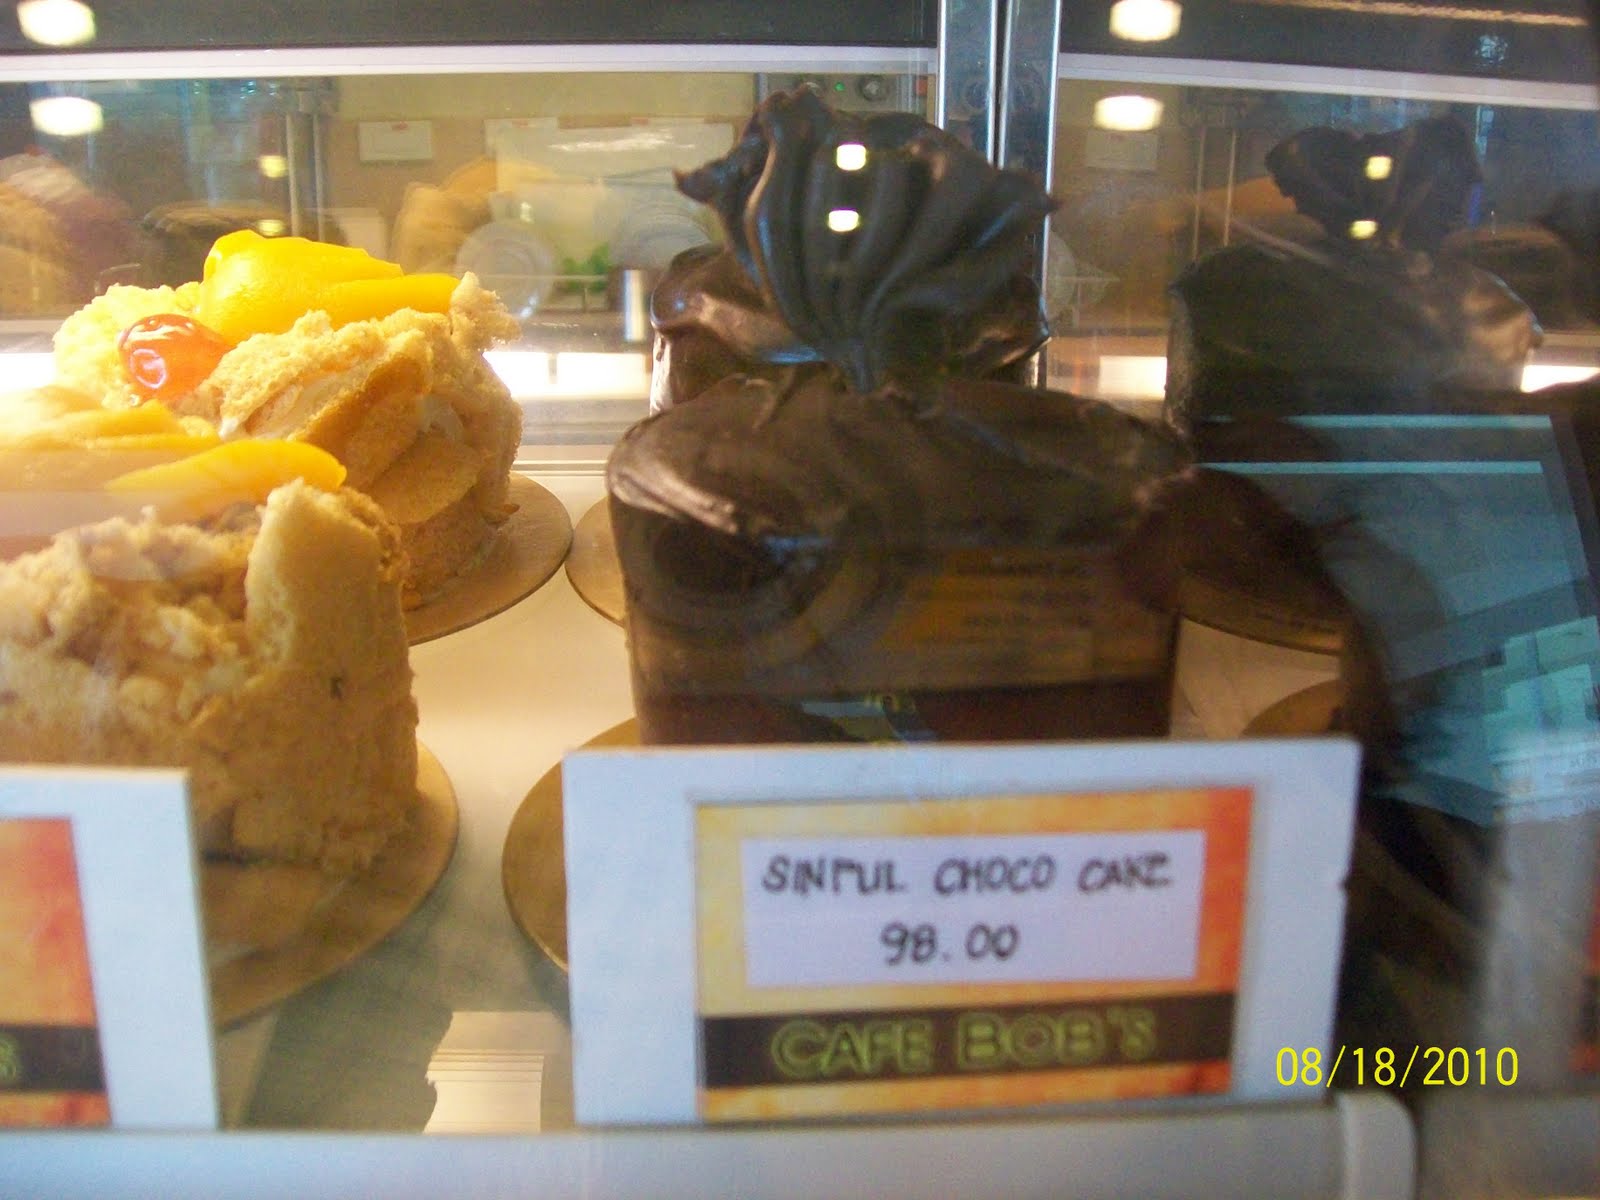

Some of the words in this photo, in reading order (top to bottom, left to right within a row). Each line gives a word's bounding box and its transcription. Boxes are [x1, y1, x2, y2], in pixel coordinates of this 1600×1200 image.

[933, 855, 1057, 896] CHOCO
[881, 921, 1020, 966] 98.00
[770, 1018, 934, 1080] CAFE
[958, 1008, 1157, 1068] BOB'S
